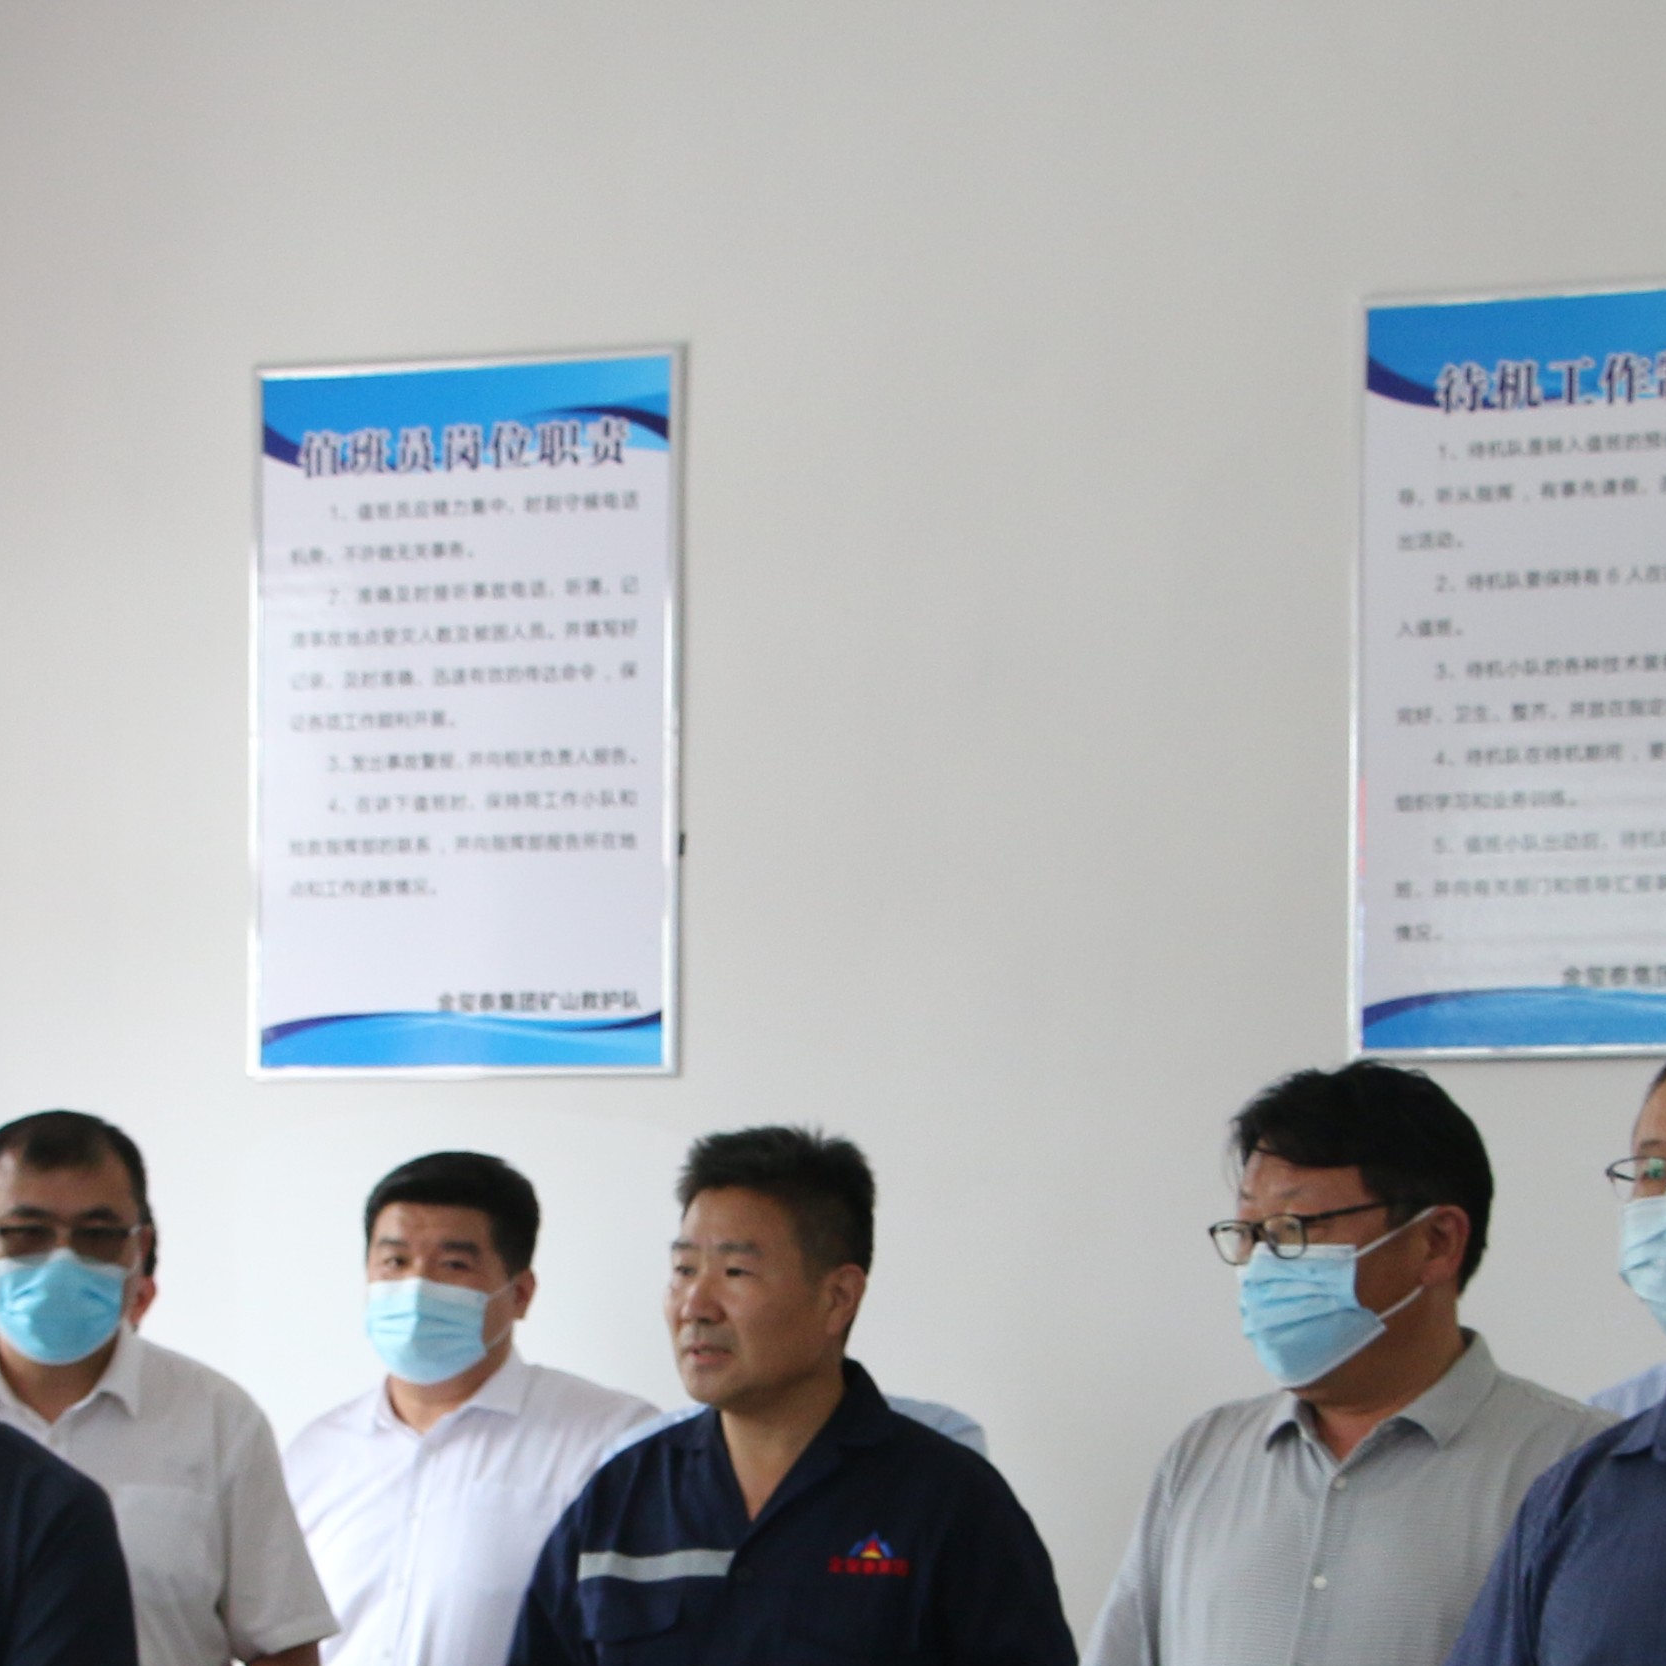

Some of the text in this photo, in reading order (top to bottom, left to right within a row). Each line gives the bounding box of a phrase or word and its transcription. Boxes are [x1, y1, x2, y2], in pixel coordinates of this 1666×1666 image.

[301, 417, 629, 478] 值班员岗位职责
